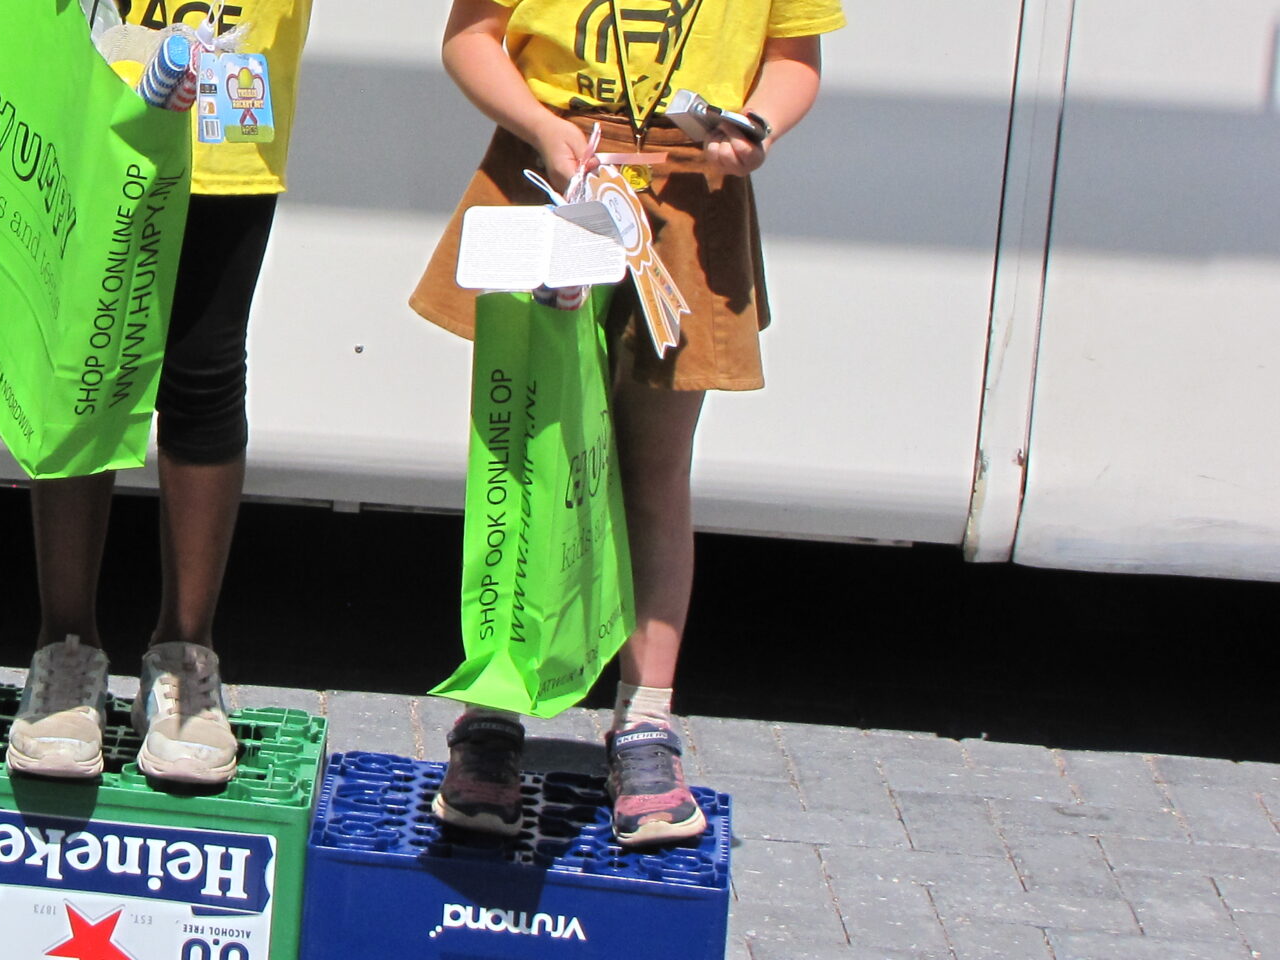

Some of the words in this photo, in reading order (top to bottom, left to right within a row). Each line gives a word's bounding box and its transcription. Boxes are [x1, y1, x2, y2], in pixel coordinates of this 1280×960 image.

[122, 163, 148, 201] OP
[9, 210, 41, 263] and
[102, 204, 134, 293] ONLINE
[109, 167, 186, 409] WWW.HUMPY.NL
[89, 298, 119, 349] OOK
[75, 355, 106, 416] SHOP
[489, 368, 513, 404] OP
[487, 410, 512, 506] ONLINE
[485, 511, 507, 568] OOK
[478, 573, 500, 641] SHOP
[33, 903, 57, 916] 1873
[183, 923, 205, 935] FREE
[209, 926, 252, 939] ALCOHOL
[441, 902, 588, 941] vrumona
